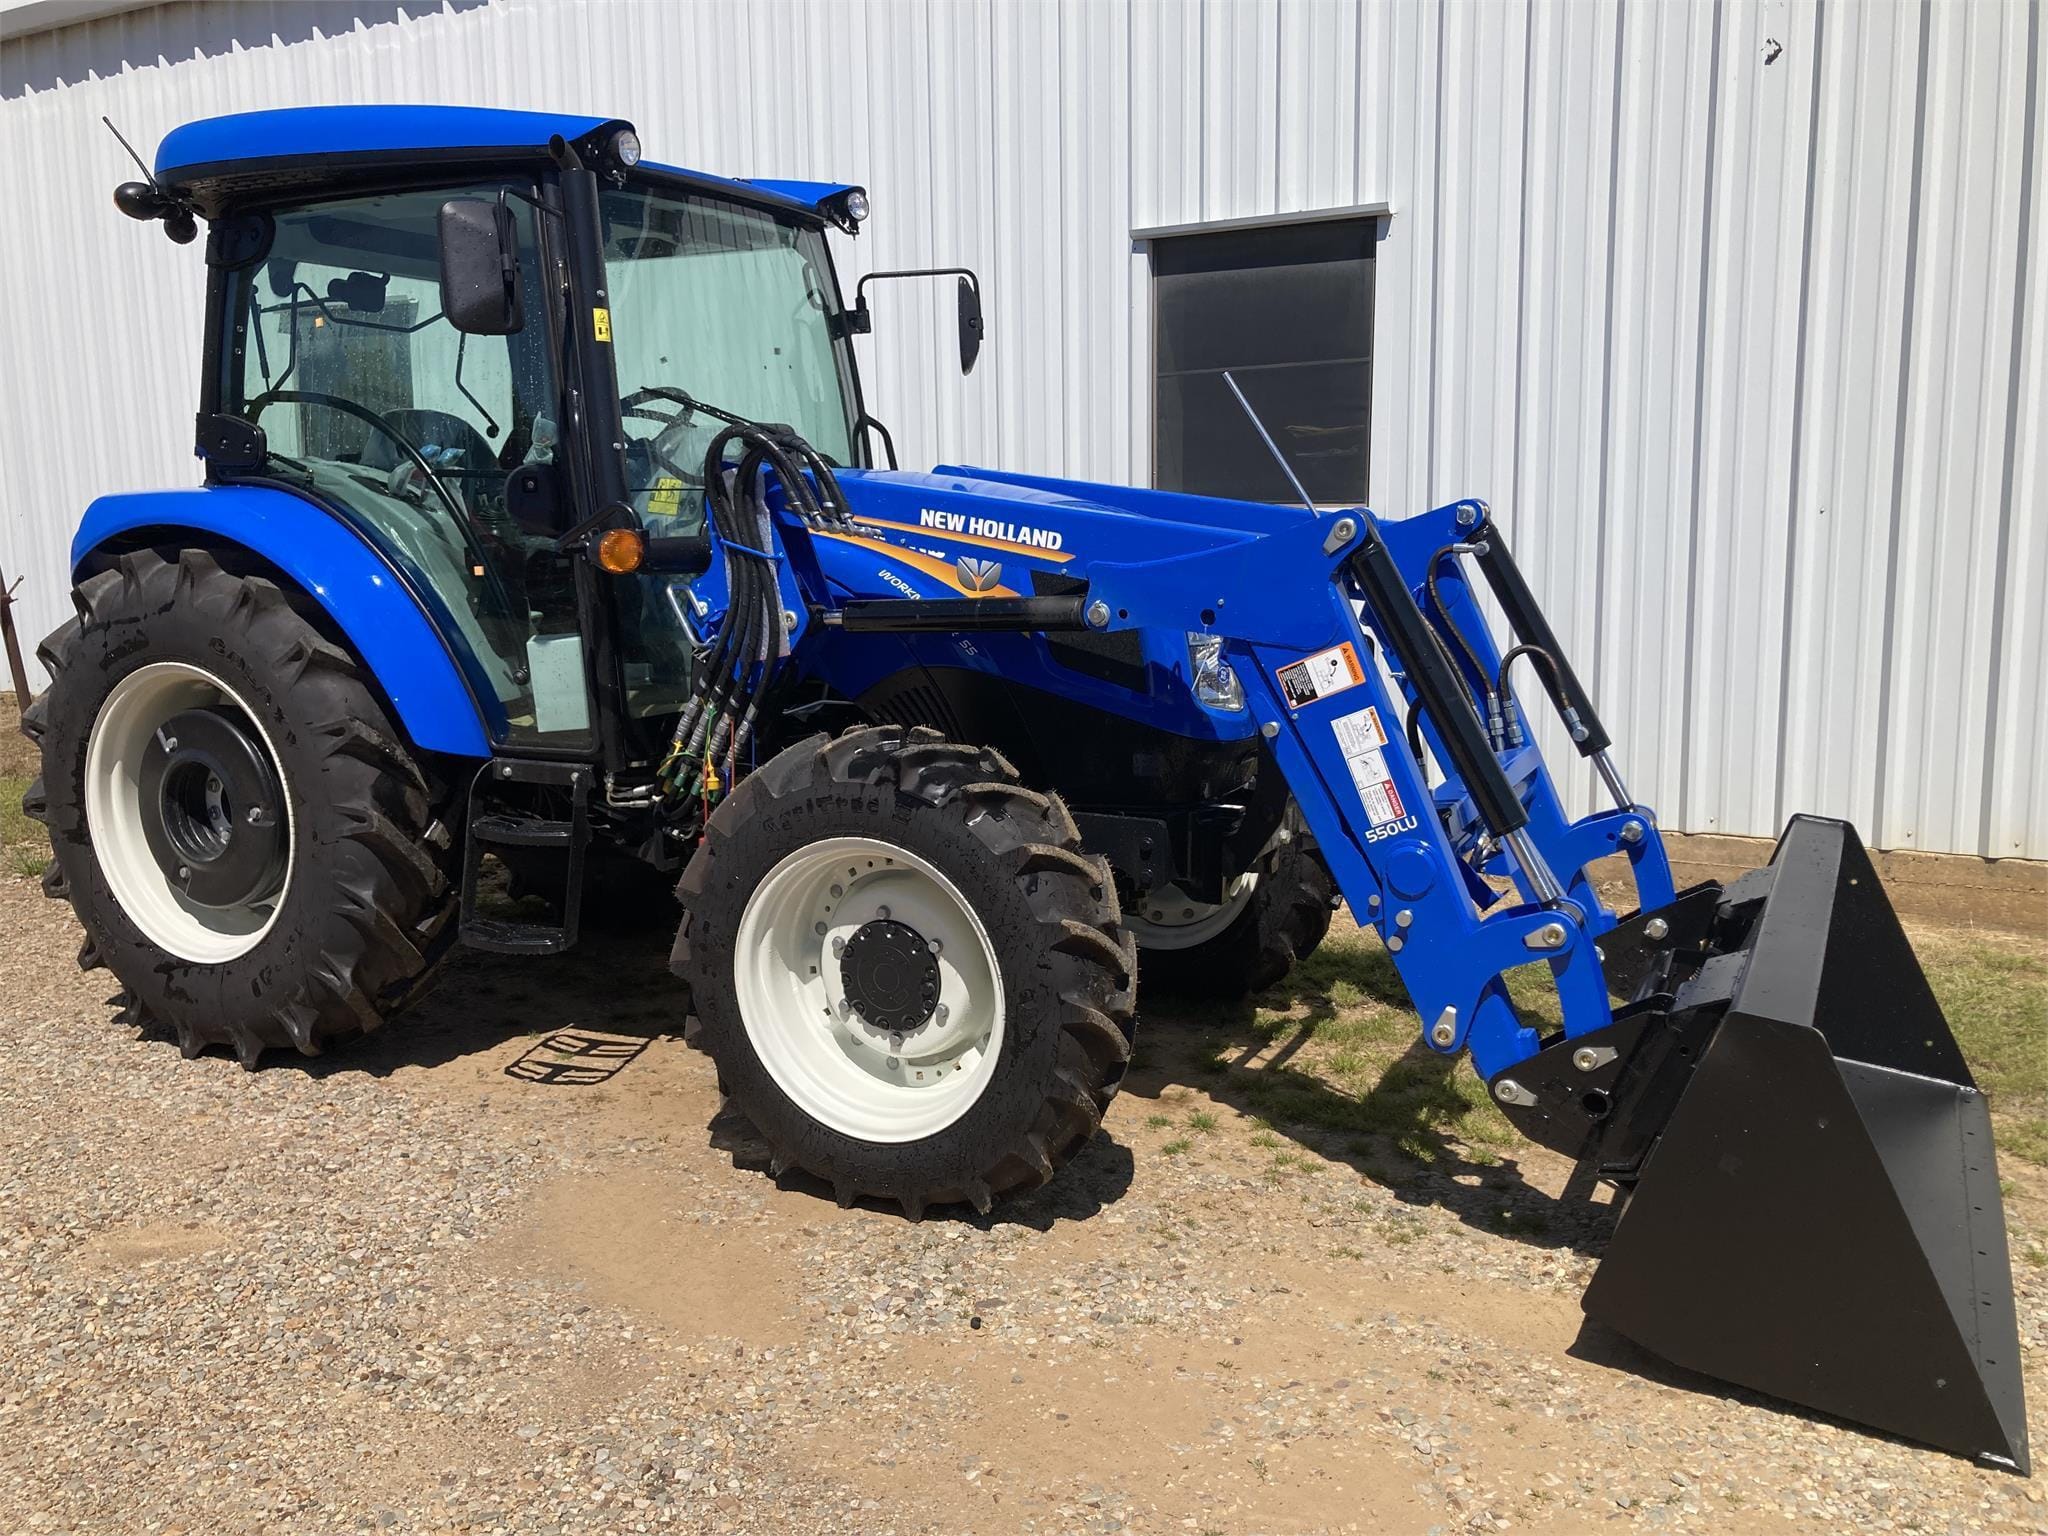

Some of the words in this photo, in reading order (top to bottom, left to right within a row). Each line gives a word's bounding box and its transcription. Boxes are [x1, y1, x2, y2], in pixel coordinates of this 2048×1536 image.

[920, 508, 967, 530] NEW
[969, 517, 1062, 550] HOLLAND
[1344, 654, 1360, 682] WARNING
[1388, 789, 1403, 816] DANGER
[1364, 815, 1418, 844] 550LU
